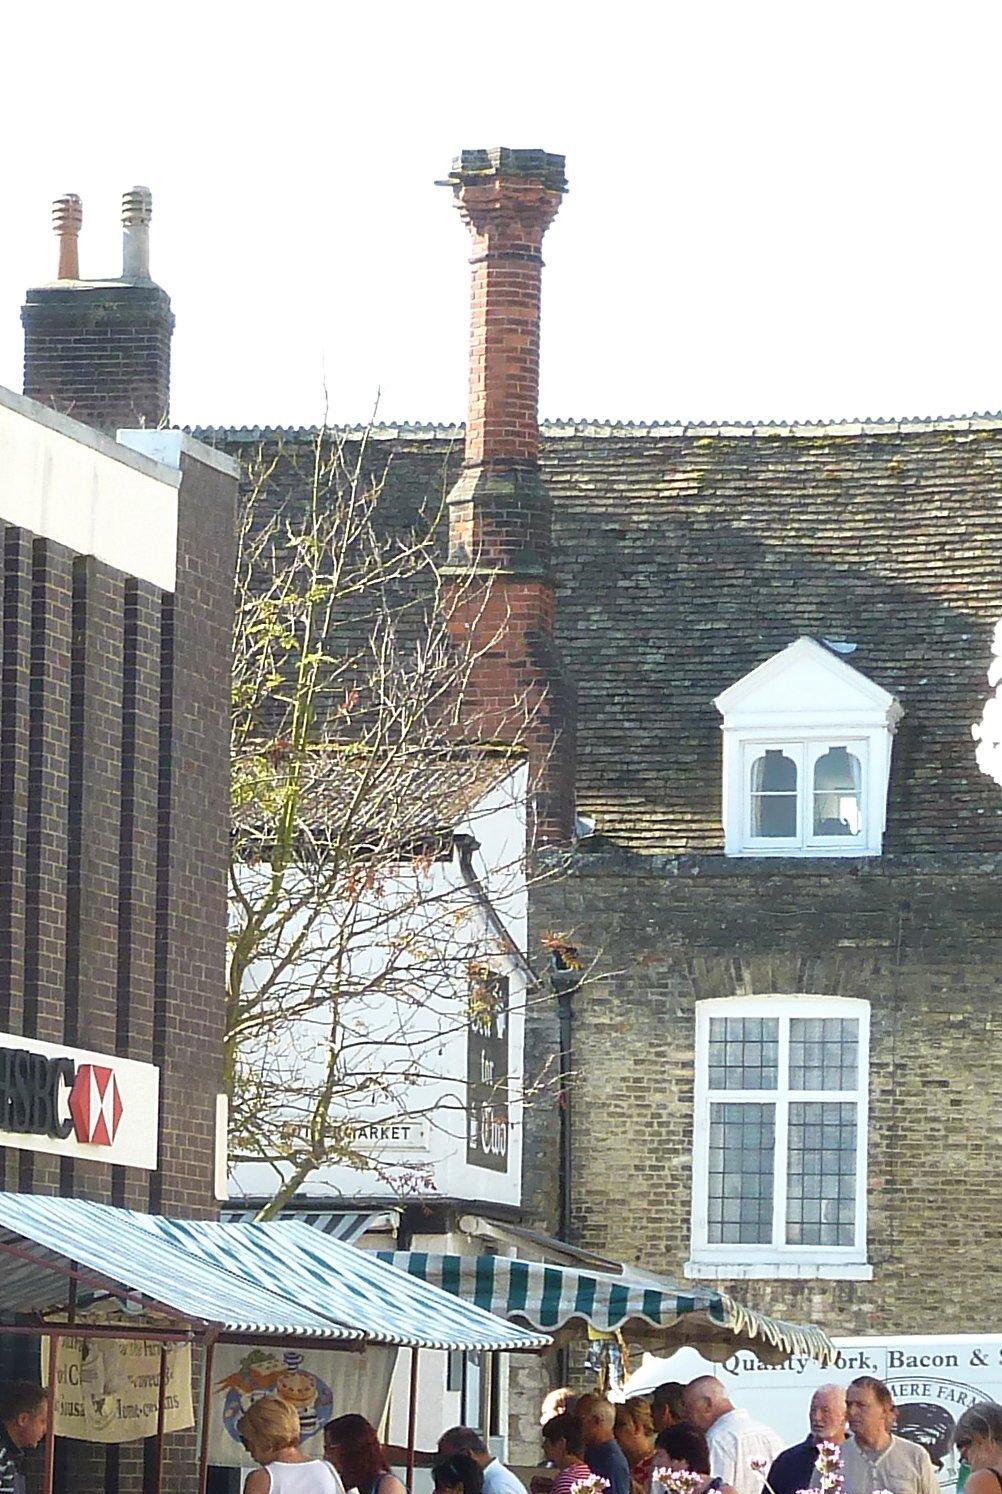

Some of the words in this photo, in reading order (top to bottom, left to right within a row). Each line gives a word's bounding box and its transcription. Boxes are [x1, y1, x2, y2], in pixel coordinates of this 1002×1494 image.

[722, 1354, 809, 1376] Quaty
[821, 1351, 878, 1373] ork,
[889, 1350, 958, 1368] Bacon
[969, 1348, 988, 1367] &
